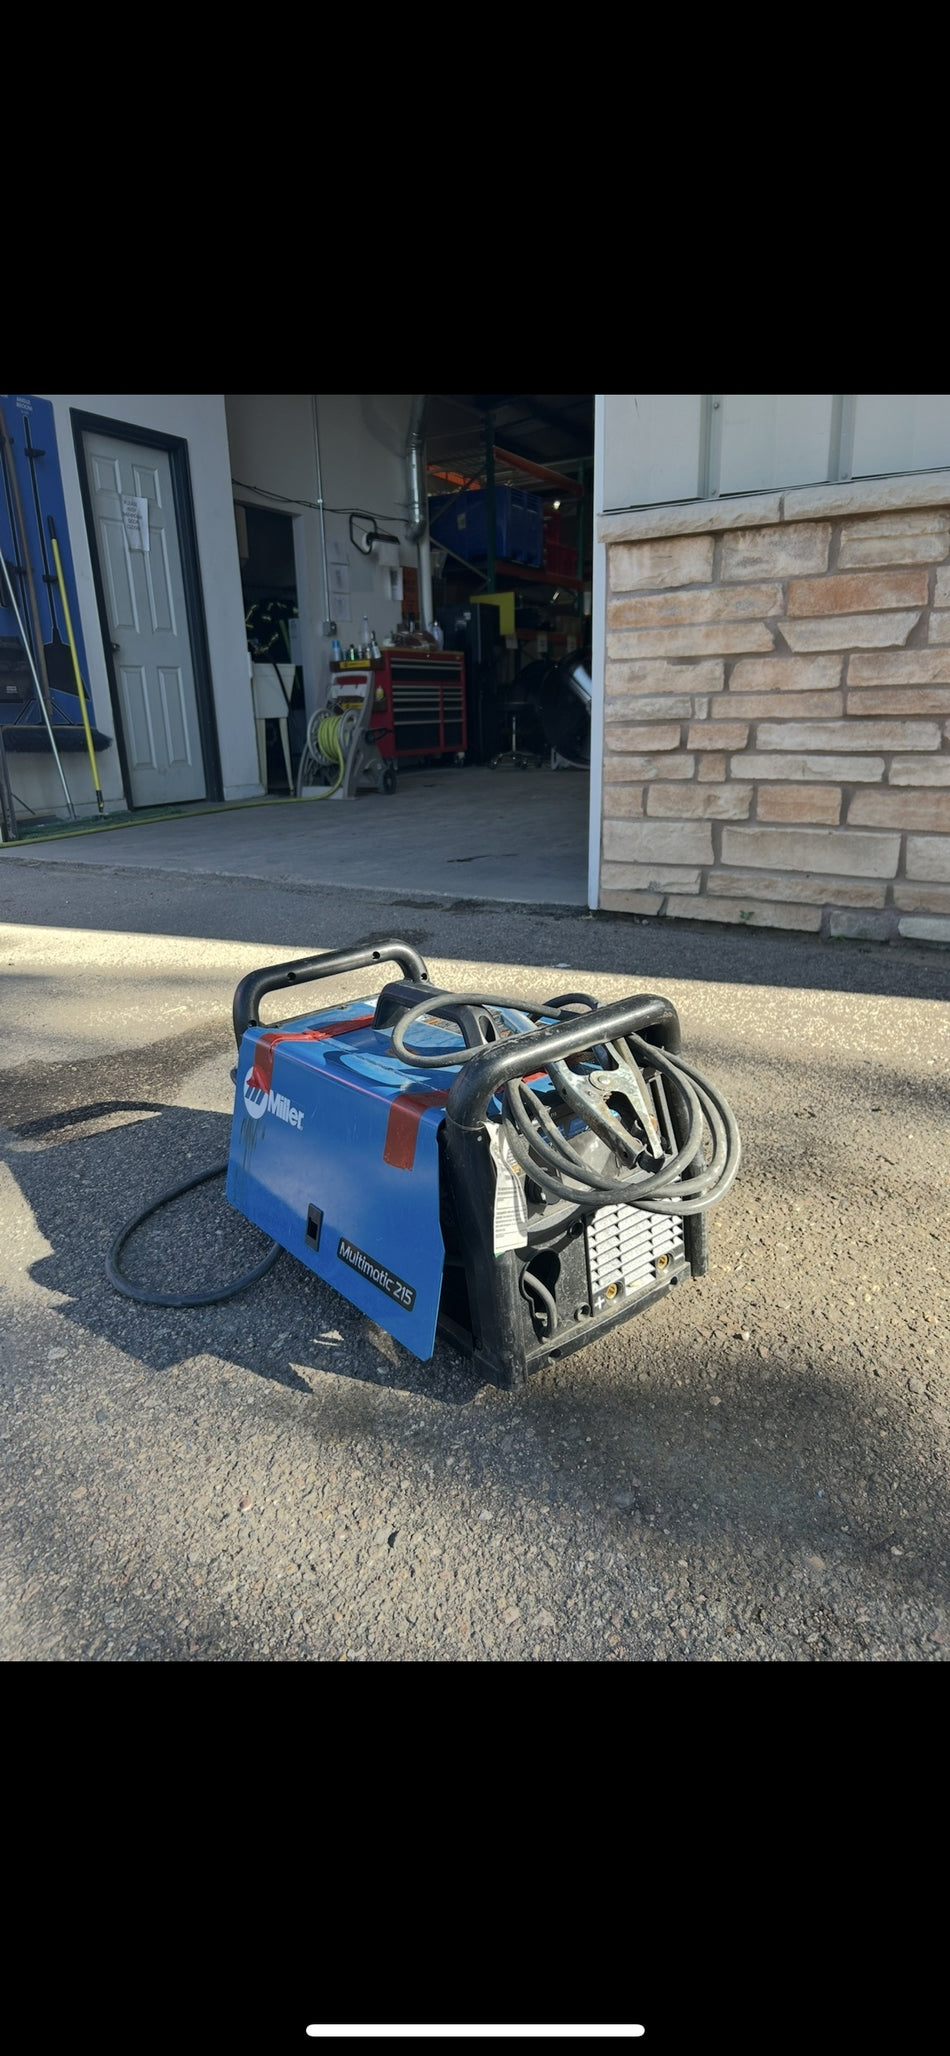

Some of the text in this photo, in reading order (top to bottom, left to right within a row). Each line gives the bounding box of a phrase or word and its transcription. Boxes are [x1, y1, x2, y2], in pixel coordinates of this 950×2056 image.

[268, 1089, 304, 1129] Miller
[340, 1242, 413, 1305] Multimatic 215
